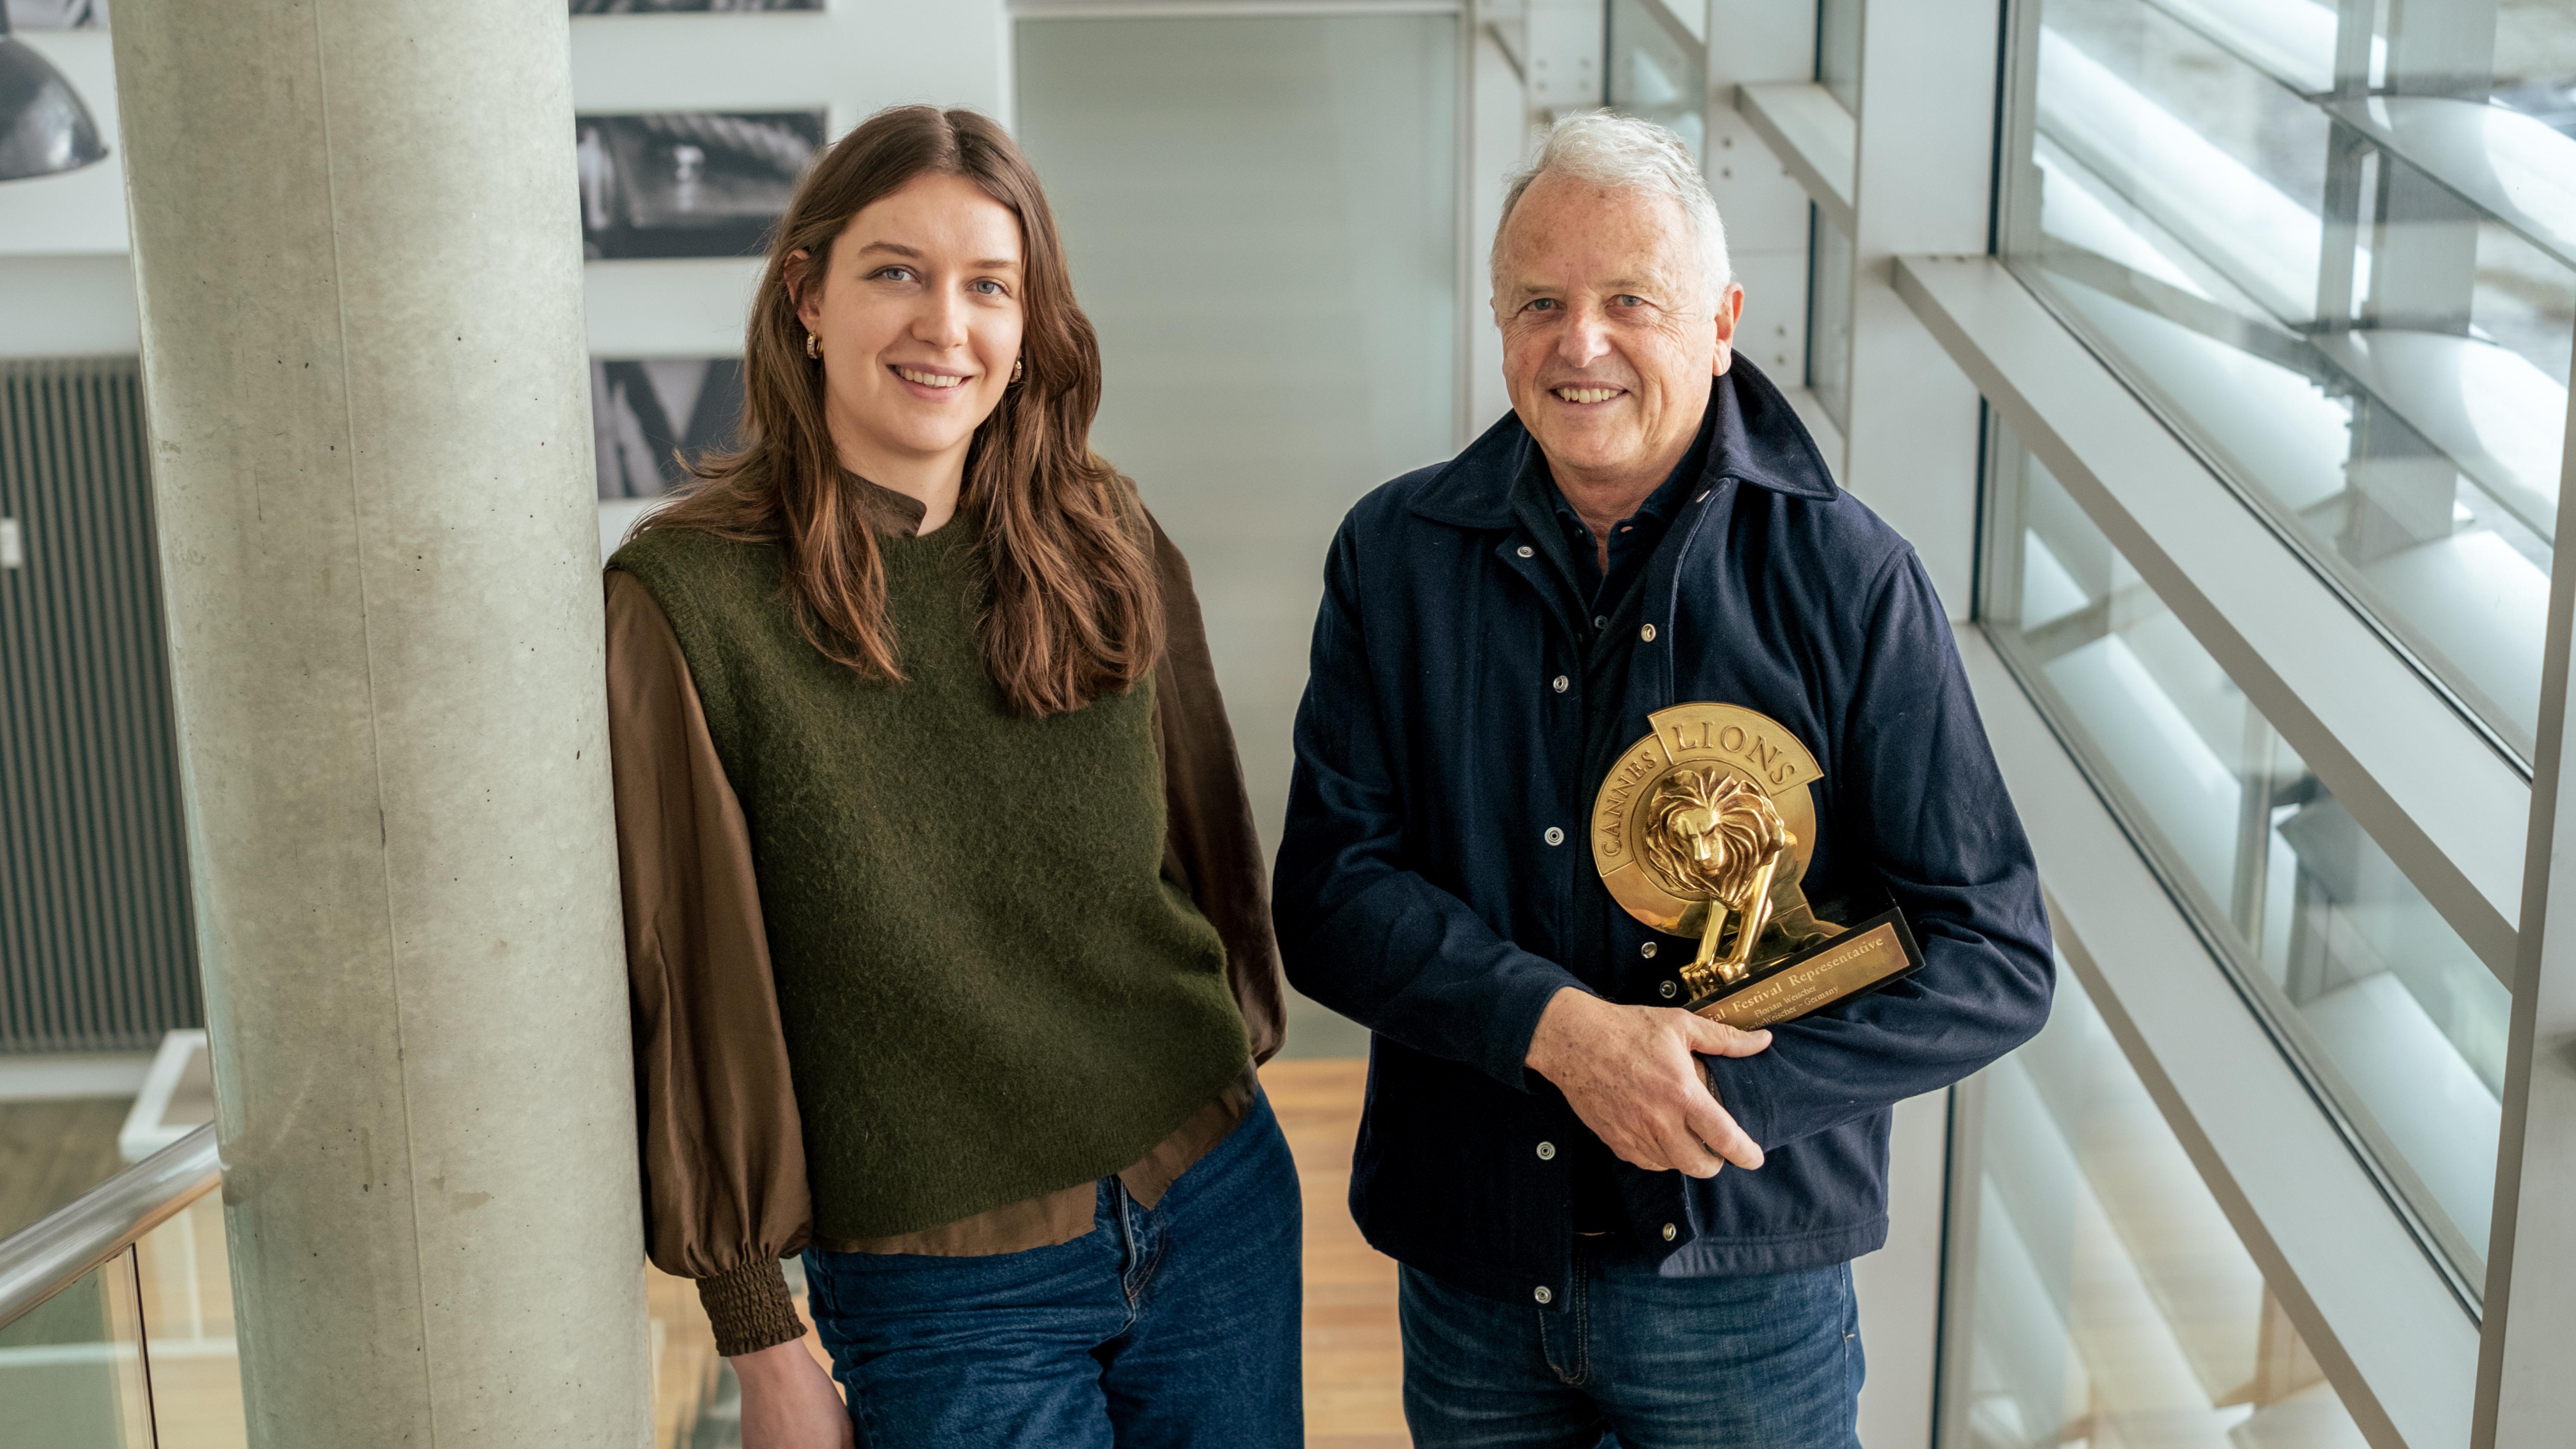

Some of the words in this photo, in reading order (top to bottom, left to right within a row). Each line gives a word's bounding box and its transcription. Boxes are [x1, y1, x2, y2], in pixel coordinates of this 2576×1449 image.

[1601, 750, 1657, 857] CANNES
[1672, 721, 1797, 785] LIONS
[1732, 982, 1783, 1012] Festival
[1788, 938, 1884, 987] Representative
[1754, 1002, 1783, 1018] Florian
[1783, 985, 1817, 1003] Weischer
[1804, 986, 1838, 1005] Germany
